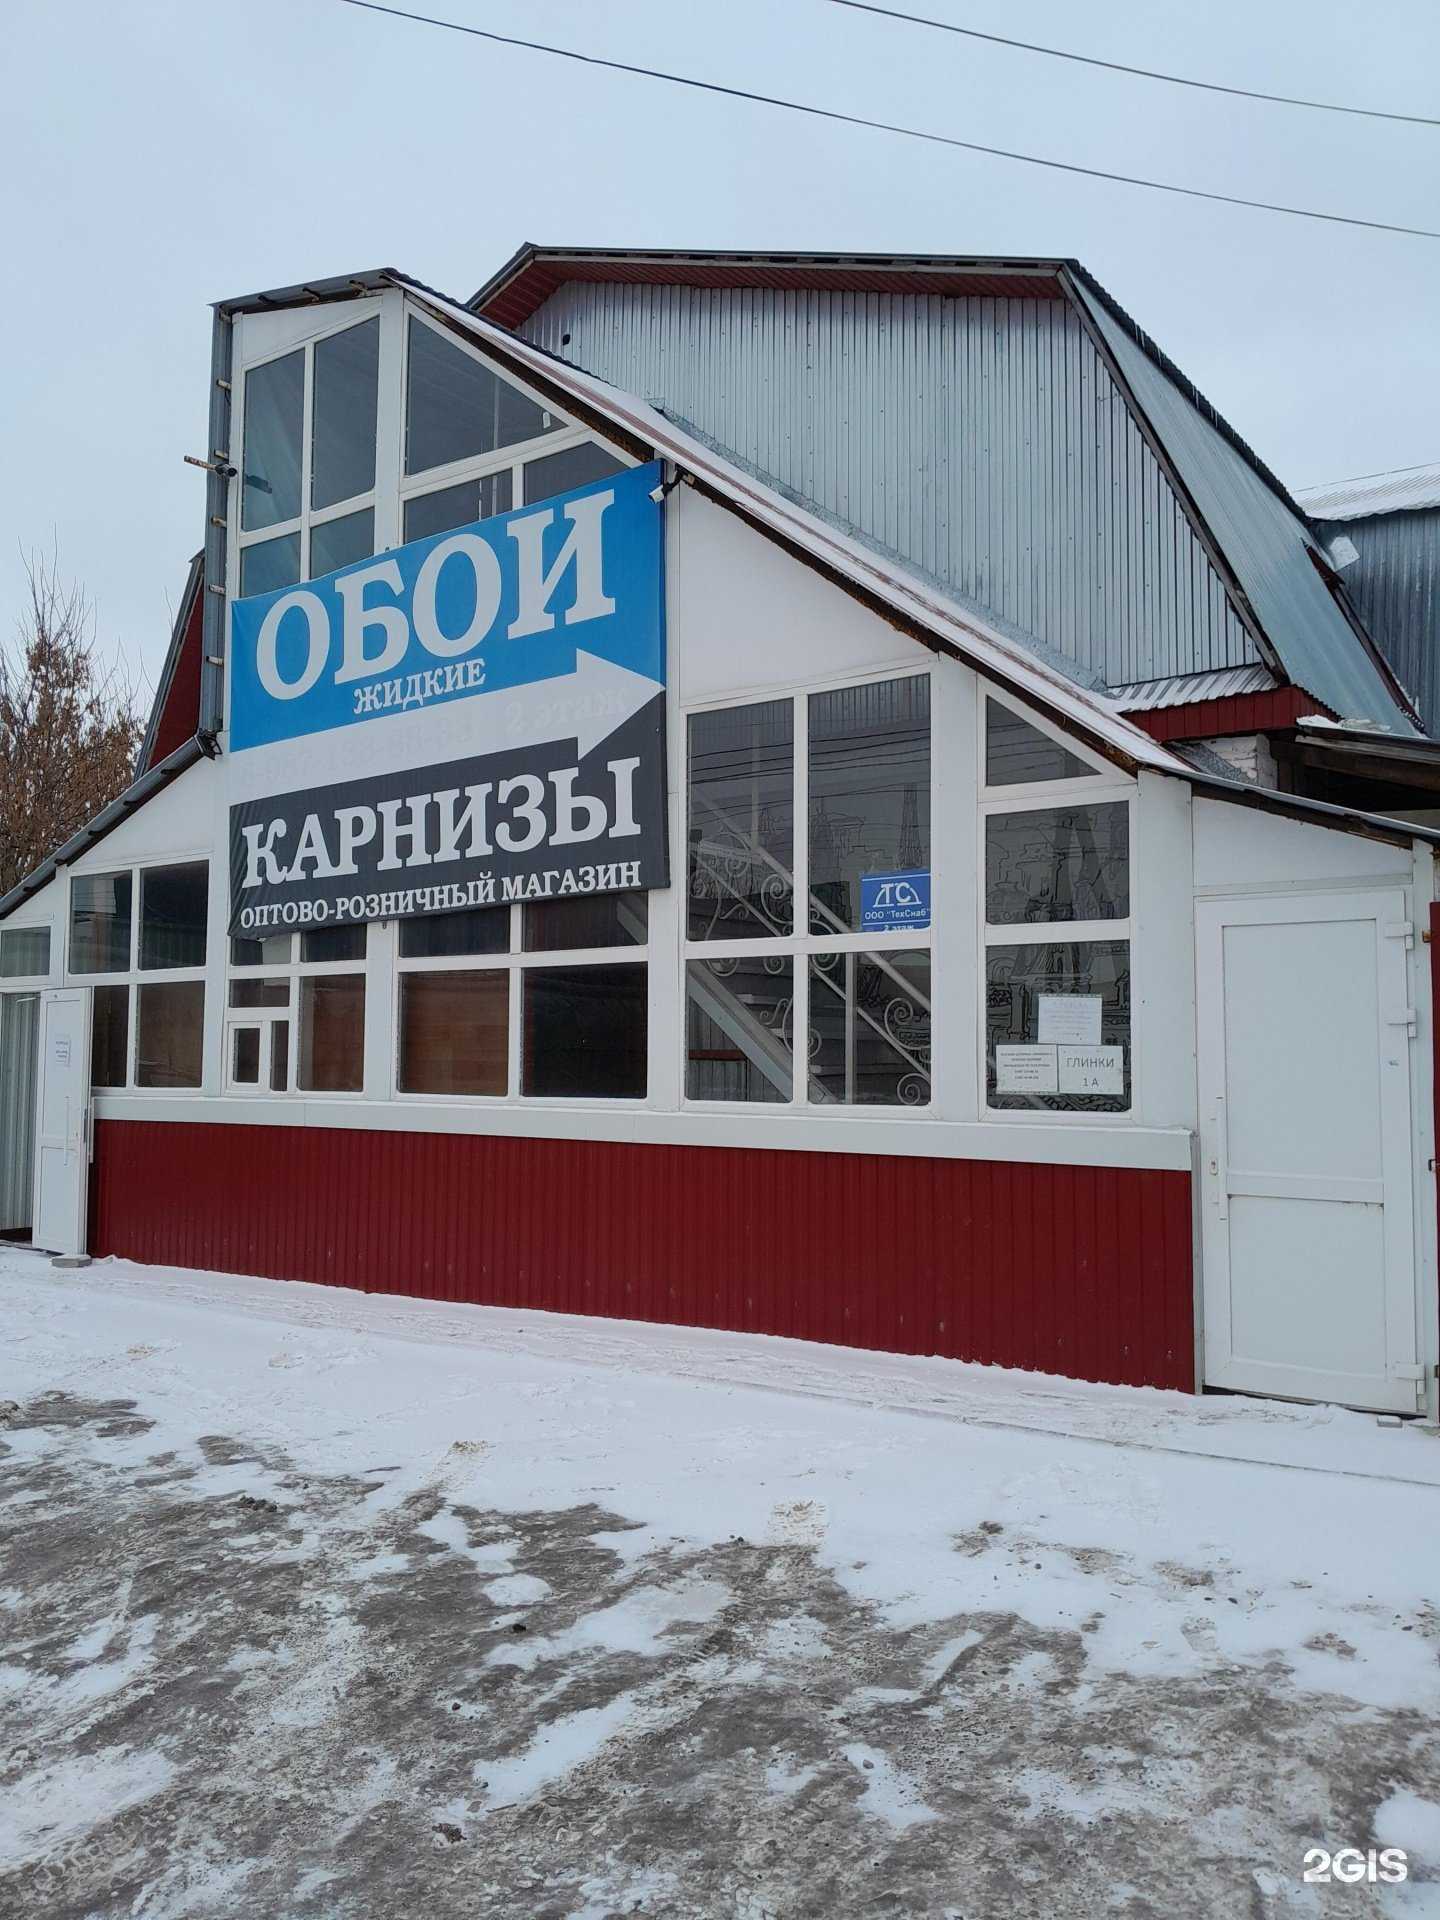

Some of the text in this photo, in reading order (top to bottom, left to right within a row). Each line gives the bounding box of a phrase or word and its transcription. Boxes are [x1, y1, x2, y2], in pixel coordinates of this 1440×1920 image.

[256, 488, 616, 701] ОБОИ
[353, 658, 486, 715] ЖИДКИЕ
[242, 757, 641, 889] КАРНИЗЫ
[240, 861, 642, 929] ОПТОВО-РОЗНИЧНЫЙ МАГАЗИН
[865, 911, 884, 920] ООО
[1066, 1056, 1115, 1069] ГЛИНКИ
